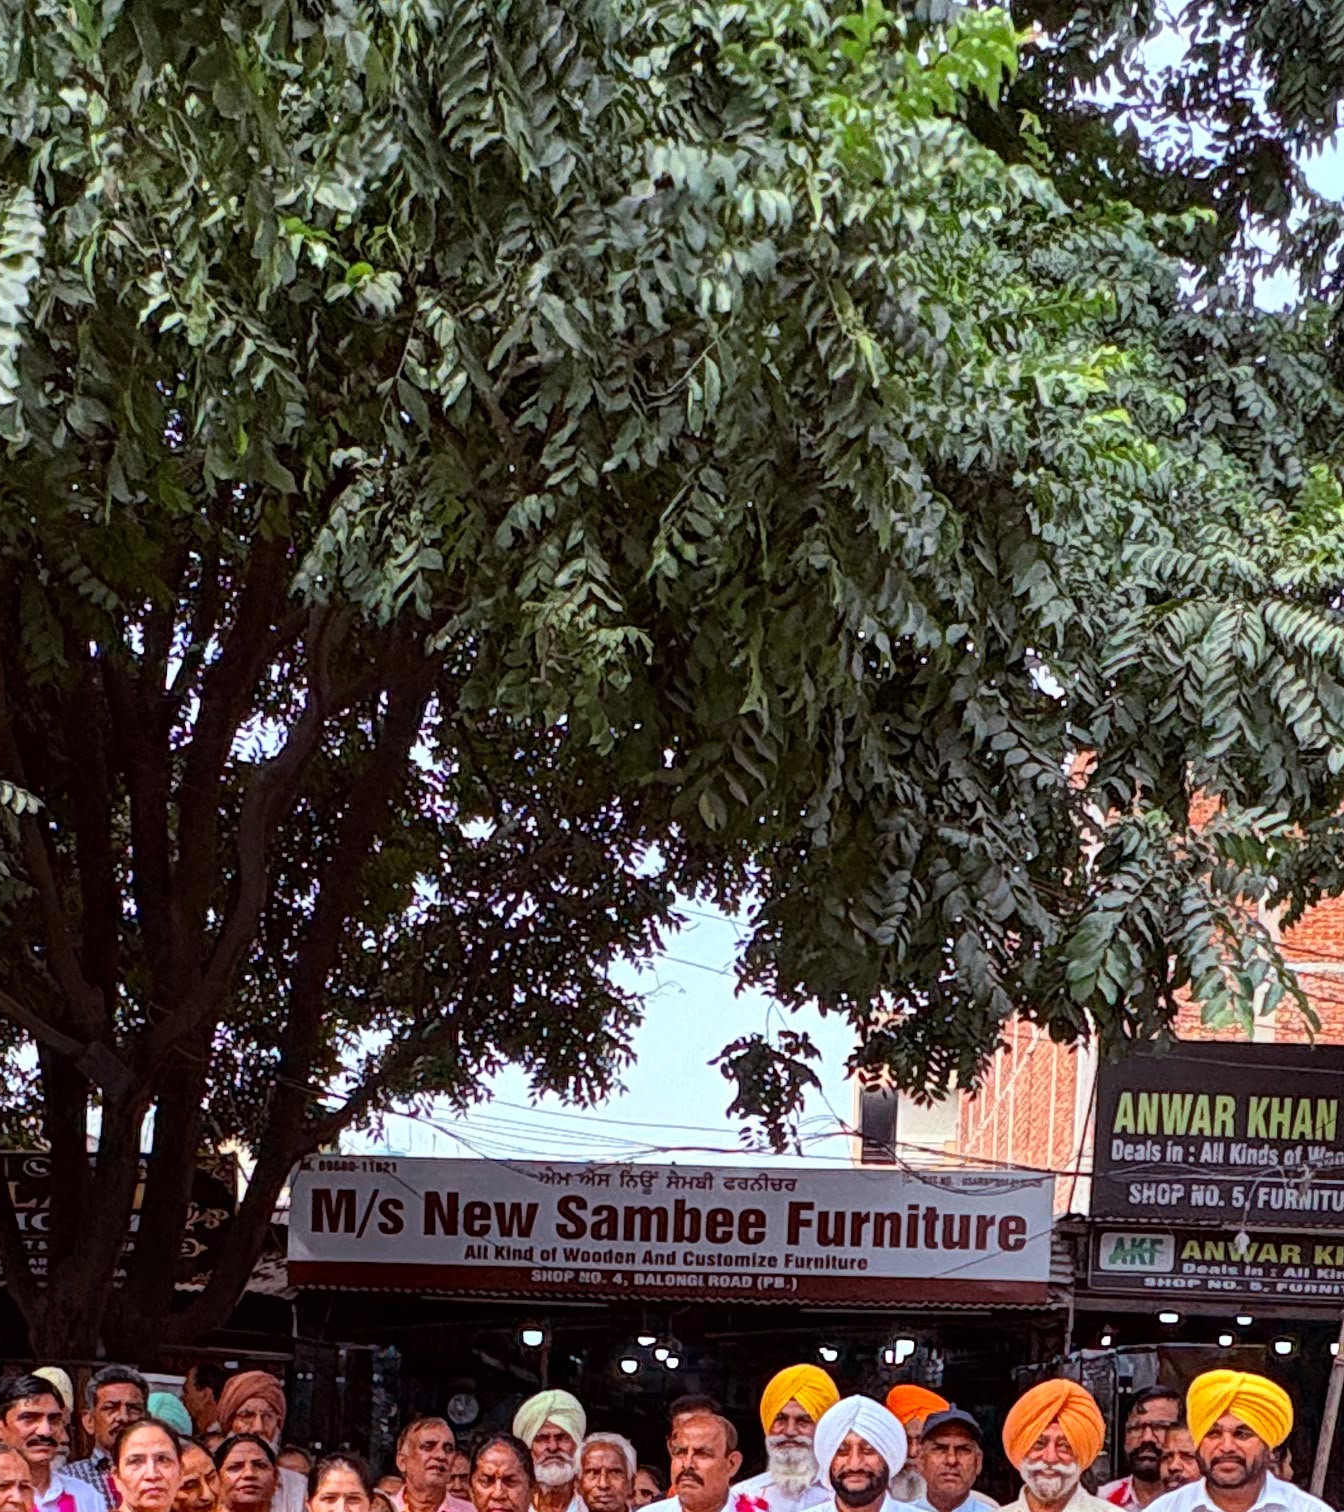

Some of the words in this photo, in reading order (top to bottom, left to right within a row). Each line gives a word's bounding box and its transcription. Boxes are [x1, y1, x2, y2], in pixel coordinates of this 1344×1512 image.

[1112, 1091, 1236, 1138] ANWAR
[1246, 1095, 1338, 1143] KHAN
[1111, 1139, 1161, 1163] Deals
[1165, 1141, 1186, 1163] in
[1199, 1142, 1224, 1164] All
[1229, 1143, 1278, 1167] Kinds
[1283, 1146, 1304, 1168] of
[1128, 1182, 1185, 1205] SHOP
[1190, 1184, 1225, 1207] NO.
[1231, 1186, 1248, 1209] 5,
[311, 1178, 404, 1239] M/s
[423, 1190, 539, 1239] New
[555, 1194, 767, 1246] Sambee
[786, 1201, 1028, 1253] Furniture
[464, 1245, 489, 1260] All
[494, 1246, 534, 1262] Kind
[540, 1246, 557, 1262] of
[563, 1248, 636, 1265] Wooden
[641, 1249, 676, 1266] And
[682, 1250, 778, 1268] Customize
[783, 1253, 869, 1271] Furniture
[1109, 1237, 1165, 1266] AKF
[1180, 1239, 1302, 1266] ANWAR
[530, 1270, 575, 1284] SHOP
[578, 1271, 607, 1284] NO.
[612, 1272, 629, 1287] 4,
[633, 1272, 705, 1288] BALONGI
[707, 1274, 753, 1289] ROAD
[757, 1275, 798, 1292] (PB.)
[1143, 1277, 1202, 1290] SHOP
[1207, 1278, 1244, 1291] NO.
[1182, 1262, 1239, 1277] Deals
[1244, 1264, 1263, 1277] in
[1282, 1267, 1310, 1280] All
